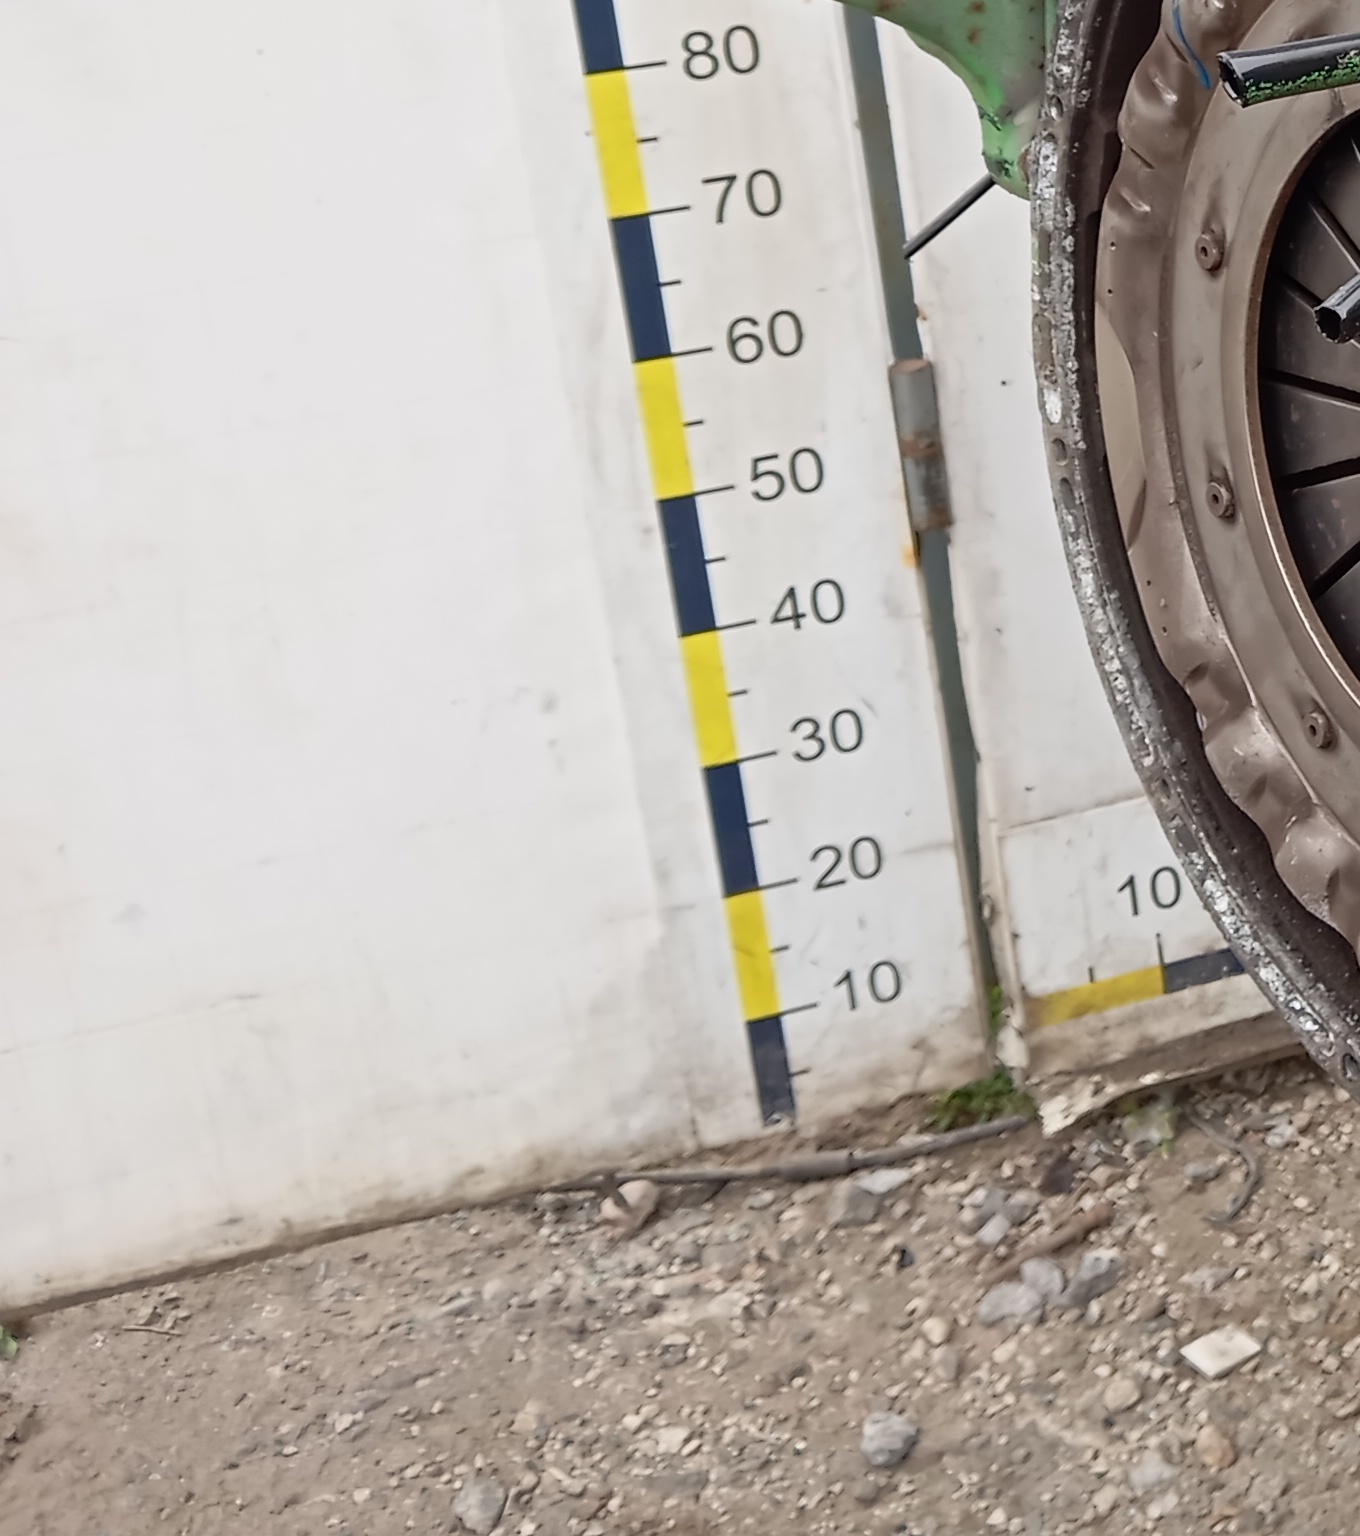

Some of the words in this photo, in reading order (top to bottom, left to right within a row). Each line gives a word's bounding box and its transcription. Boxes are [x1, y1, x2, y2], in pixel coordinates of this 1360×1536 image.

[682, 25, 760, 80] 80
[701, 169, 782, 224] 70
[727, 310, 804, 364] 60
[750, 447, 824, 502] 50
[770, 578, 845, 630] 40
[790, 708, 864, 762] 30
[810, 836, 884, 891] 20
[1117, 866, 1182, 916] 10
[834, 960, 902, 1011] 10
